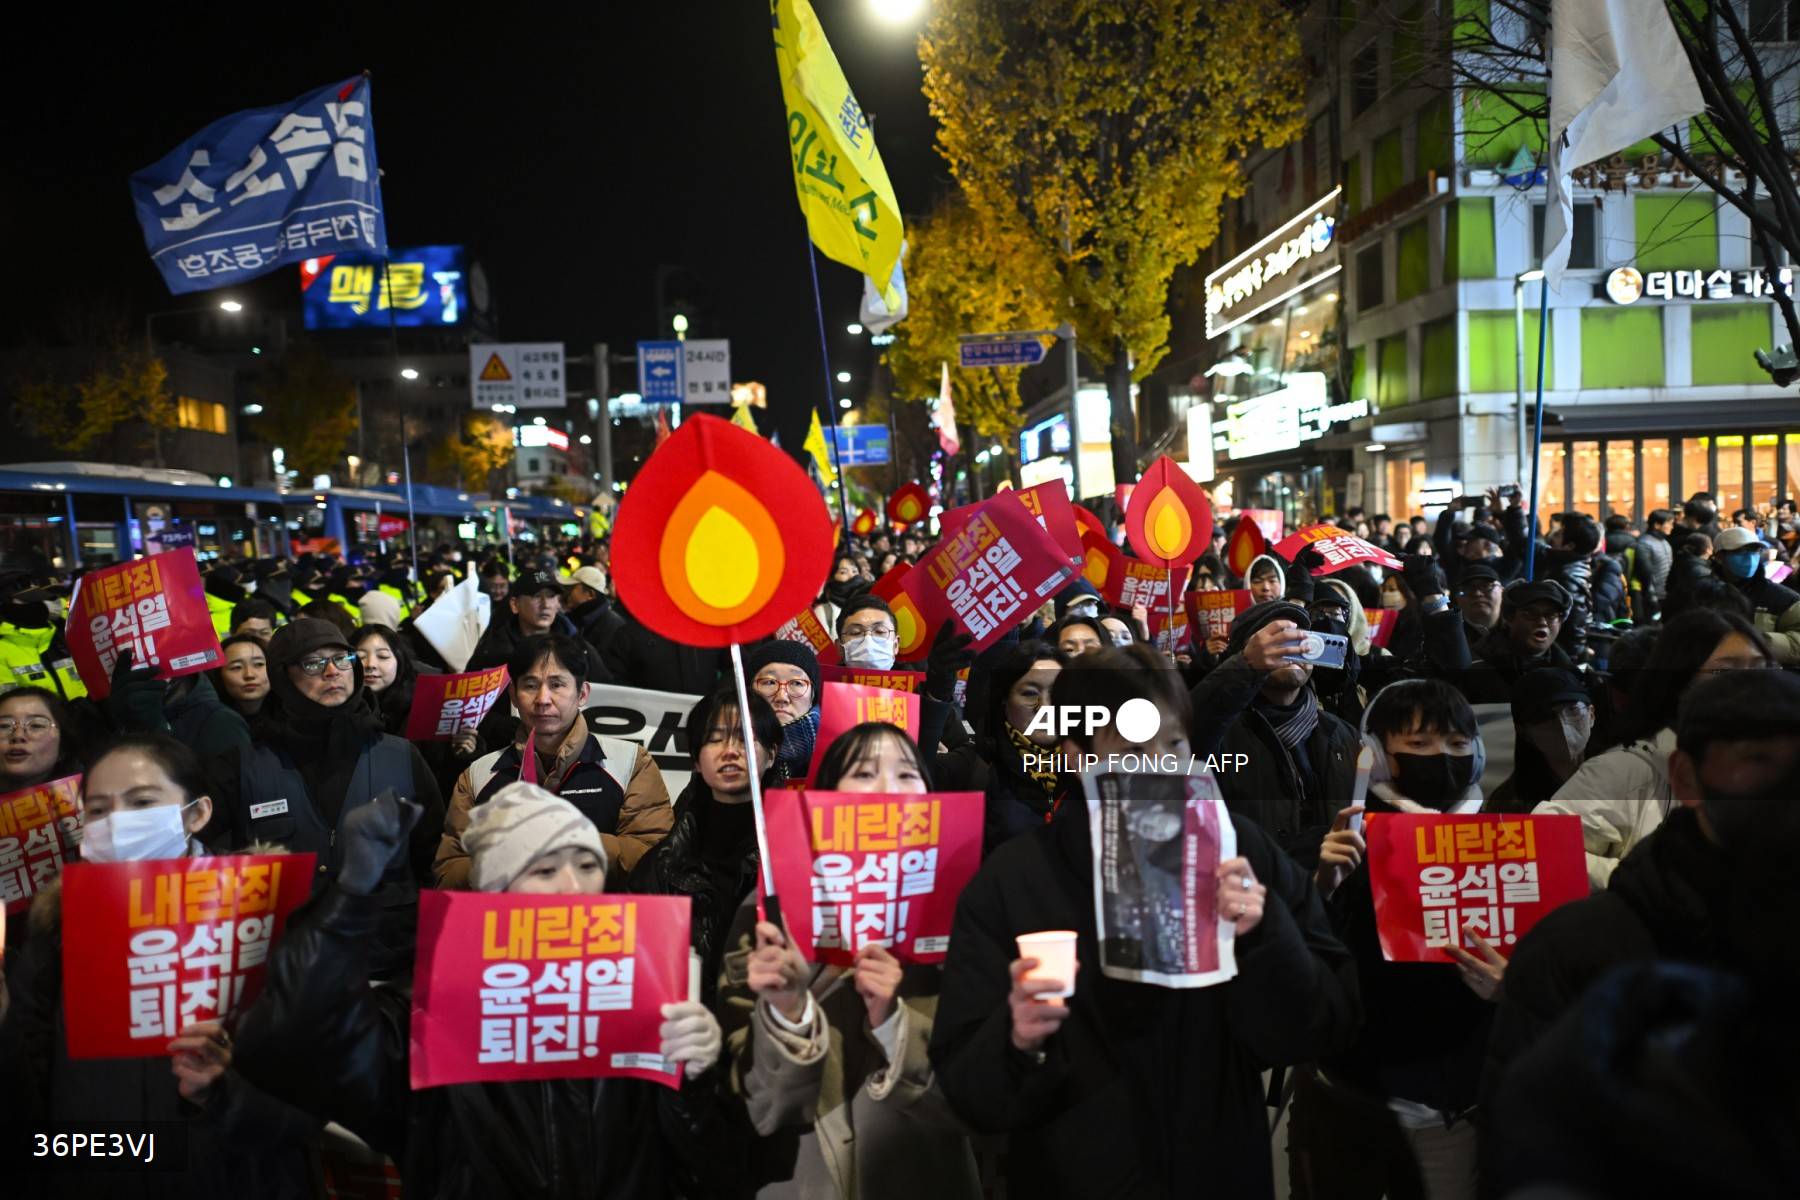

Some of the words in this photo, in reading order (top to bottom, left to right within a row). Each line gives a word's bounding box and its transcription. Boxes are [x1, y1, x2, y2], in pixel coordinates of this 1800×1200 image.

[328, 262, 429, 316] 맥콜
[927, 511, 1002, 590] 내란죄
[946, 536, 1023, 617] 윤석열
[81, 559, 162, 617] 내란죄
[962, 576, 1028, 641] 퇴진!
[90, 593, 171, 649] 윤석열
[444, 667, 505, 699] 내란죄
[812, 800, 941, 852] 내란죄
[1415, 820, 1536, 864] 내란죄
[128, 862, 282, 928] 내란죄
[810, 847, 938, 903] 윤석열
[1419, 861, 1540, 907] 윤석열
[128, 914, 275, 986] 윤석열
[482, 902, 637, 960] 내란죄
[811, 901, 910, 951] 퇴진!
[1422, 907, 1517, 948] 퇴진!
[479, 957, 635, 1015] 윤석열
[478, 1015, 599, 1063] 퇴진!
